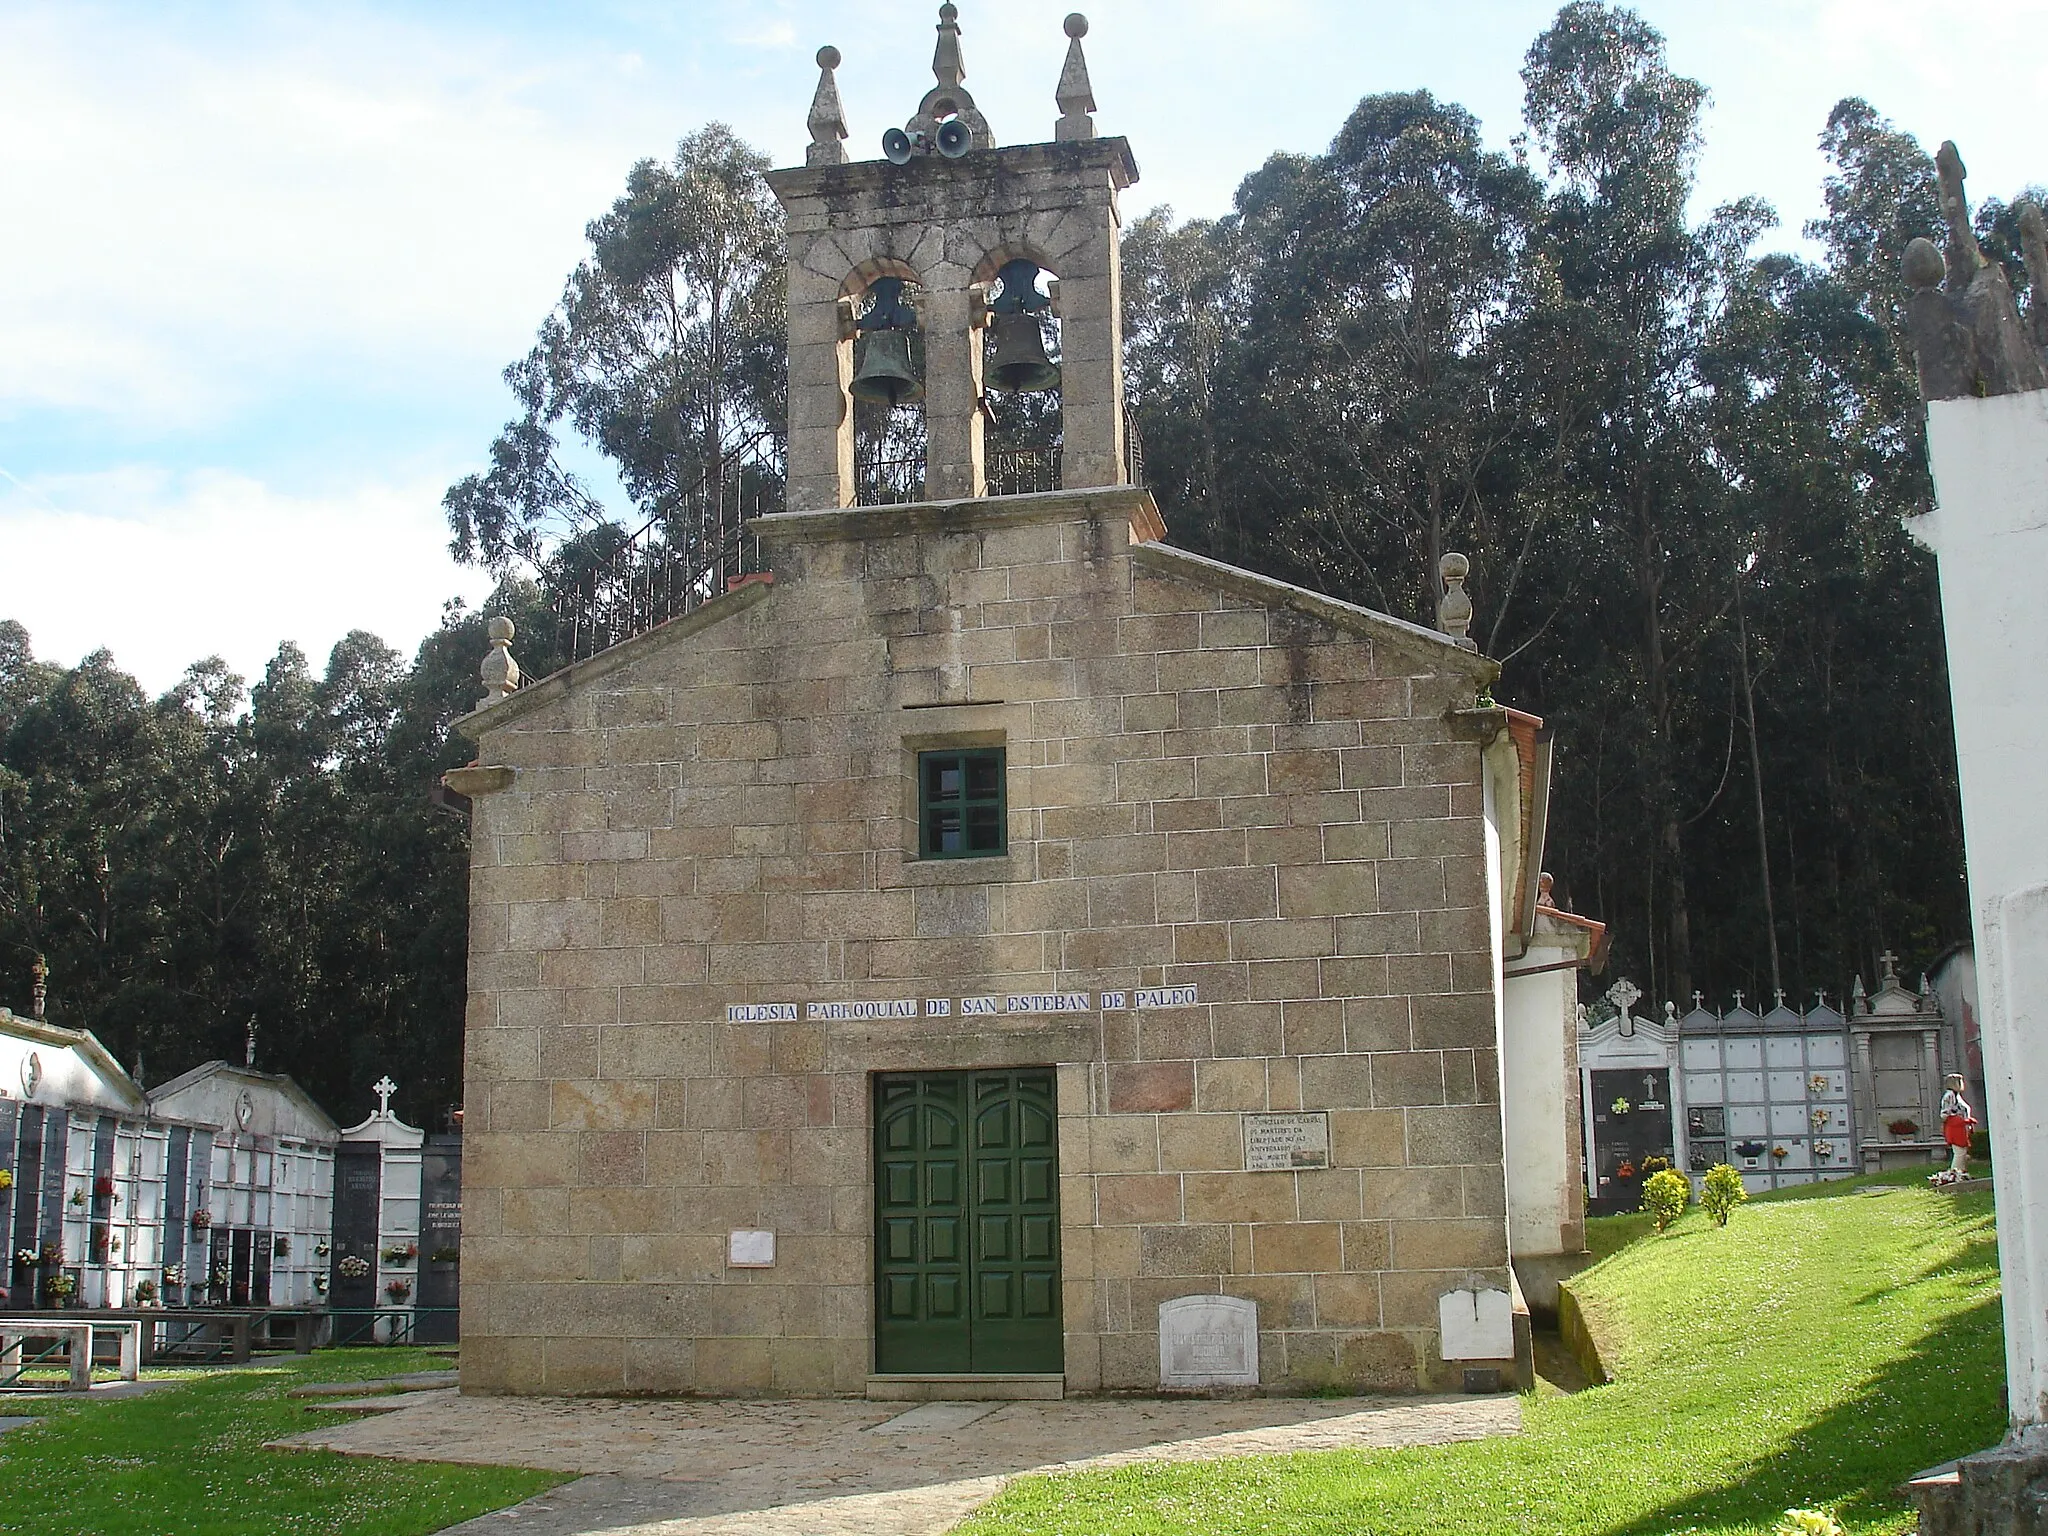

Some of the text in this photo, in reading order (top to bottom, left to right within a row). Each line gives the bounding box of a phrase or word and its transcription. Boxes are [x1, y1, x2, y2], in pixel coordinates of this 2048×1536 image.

[728, 1004, 796, 1022] IGLESIA
[927, 999, 949, 1015] DE
[962, 998, 996, 1014] SAN
[1007, 993, 1090, 1012] ESTEBAN
[1102, 992, 1125, 1009] DE
[1135, 988, 1195, 1008] PALEO
